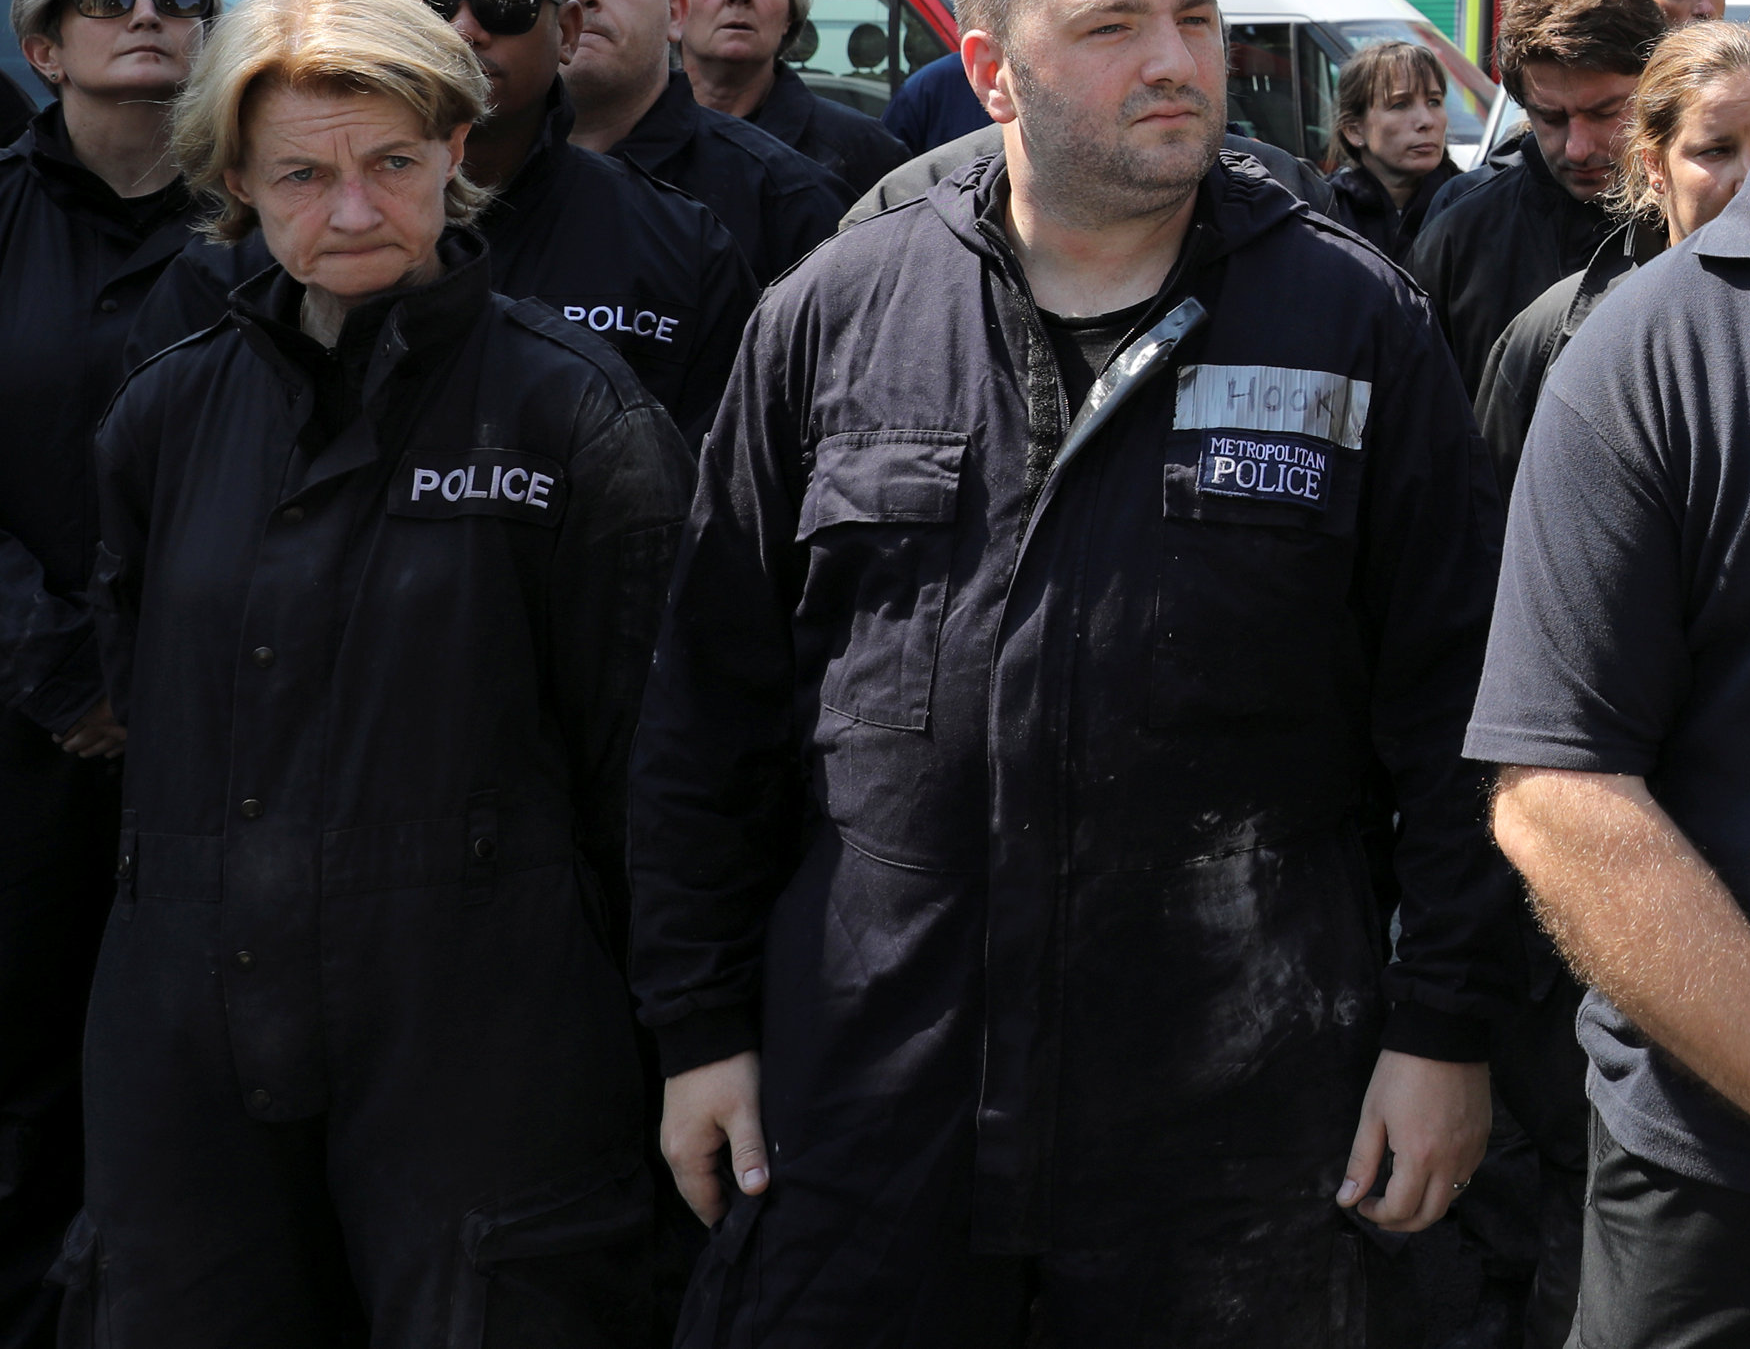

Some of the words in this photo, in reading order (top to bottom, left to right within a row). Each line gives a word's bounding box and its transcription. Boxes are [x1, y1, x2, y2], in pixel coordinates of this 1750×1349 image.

[564, 306, 680, 343] POLCE
[1226, 376, 1336, 419] HOOK
[1210, 437, 1326, 472] METROPOLITAN
[411, 466, 554, 509] POLICE
[1211, 456, 1321, 501] POLICE
